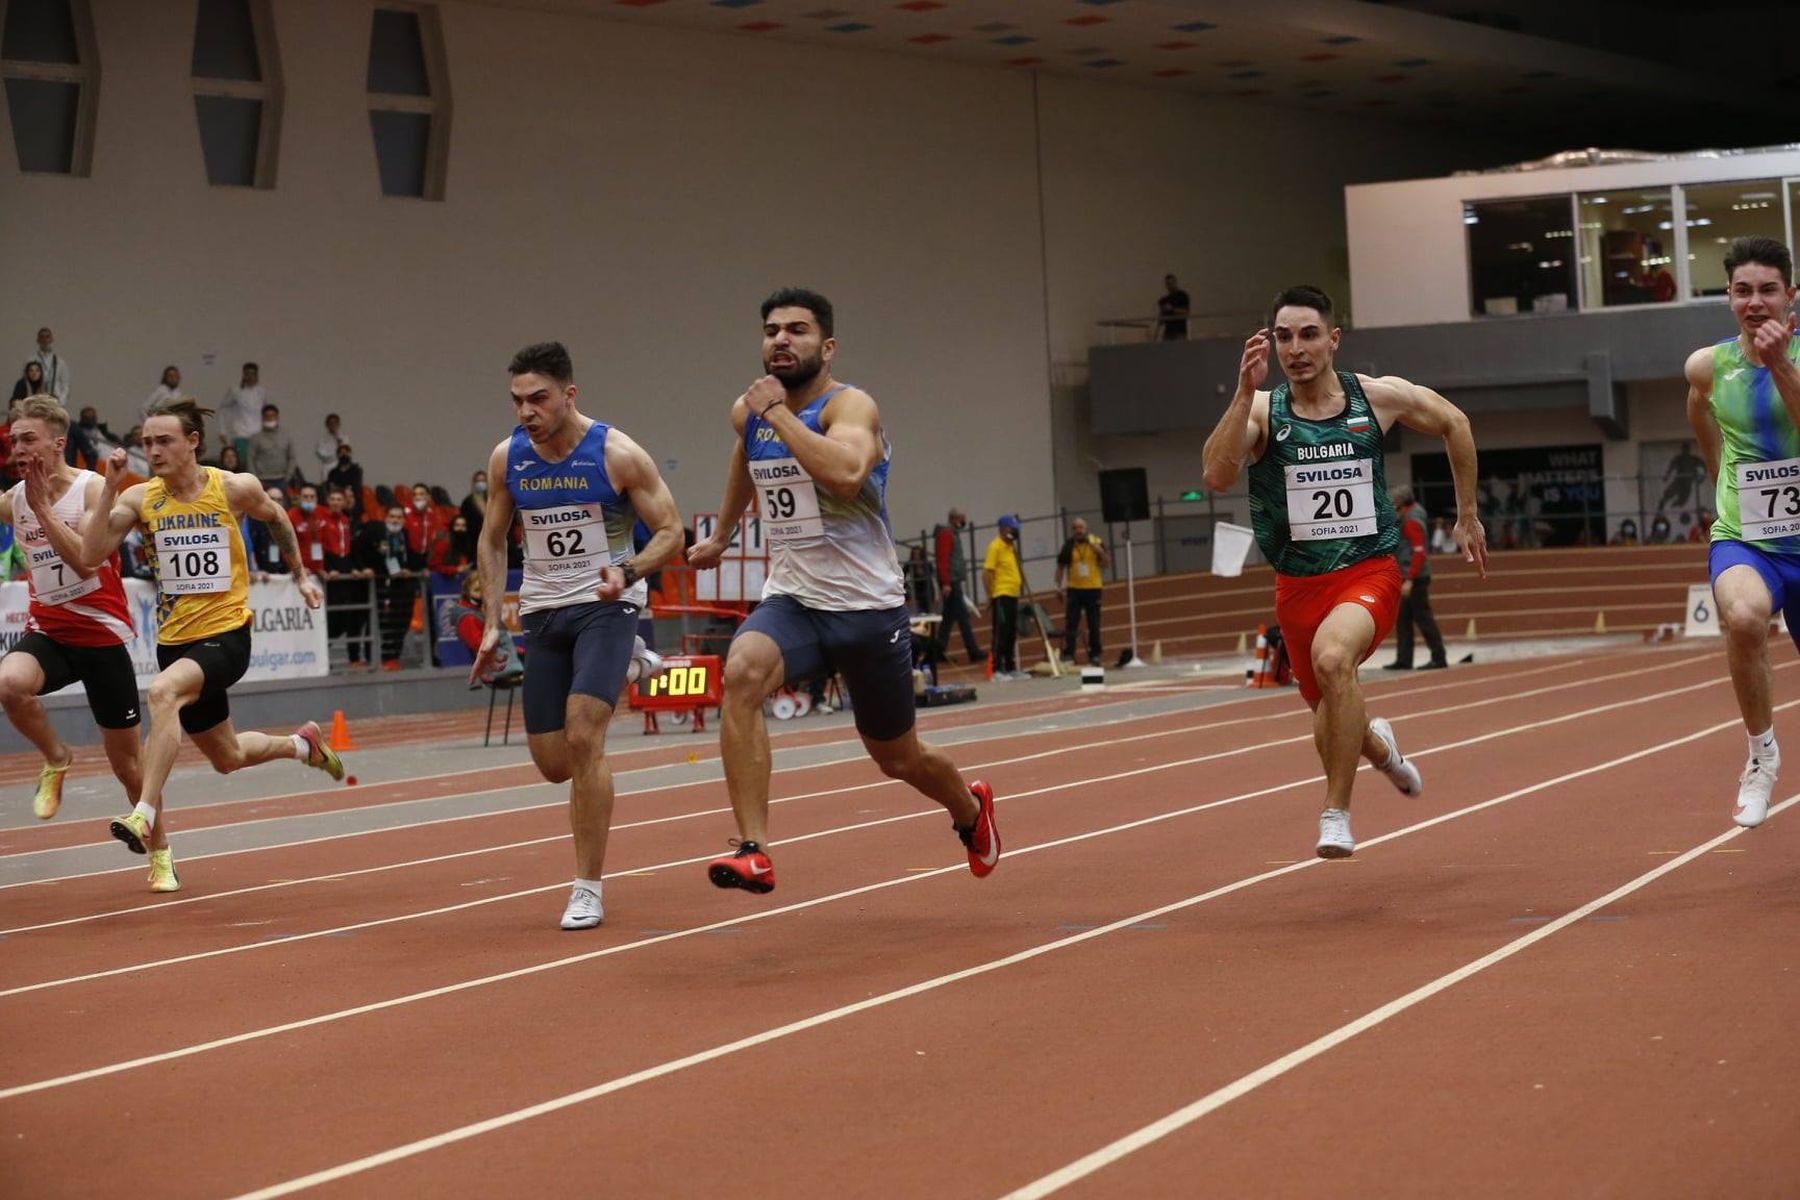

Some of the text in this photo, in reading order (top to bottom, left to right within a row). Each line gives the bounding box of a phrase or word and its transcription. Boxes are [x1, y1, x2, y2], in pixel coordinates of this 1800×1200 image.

[1296, 442, 1355, 460] BULGARIA
[1548, 451, 1597, 467] WHAT
[753, 464, 800, 480] SVILOSA
[1296, 467, 1363, 483] SVILOSA
[1745, 465, 1800, 482] SVILOS
[519, 477, 589, 491] ROMANIA
[765, 487, 796, 519] 59
[1312, 488, 1354, 520] 20
[1760, 486, 1800, 518] 73
[157, 513, 221, 531] UKRAINE
[531, 509, 592, 525] SVILOSA
[1311, 525, 1359, 536] SOFIA 2021
[1762, 525, 1788, 535] SOFIA
[163, 534, 219, 546] SVILOSA
[546, 529, 586, 557] 62
[169, 551, 219, 578] 108
[548, 560, 591, 571] SOFIA 2021
[51, 563, 64, 586] 7
[176, 582, 214, 591] SOFIA 2021
[252, 606, 314, 632] LGARIA
[1693, 600, 1709, 623] 6
[649, 667, 706, 696] 1:00
